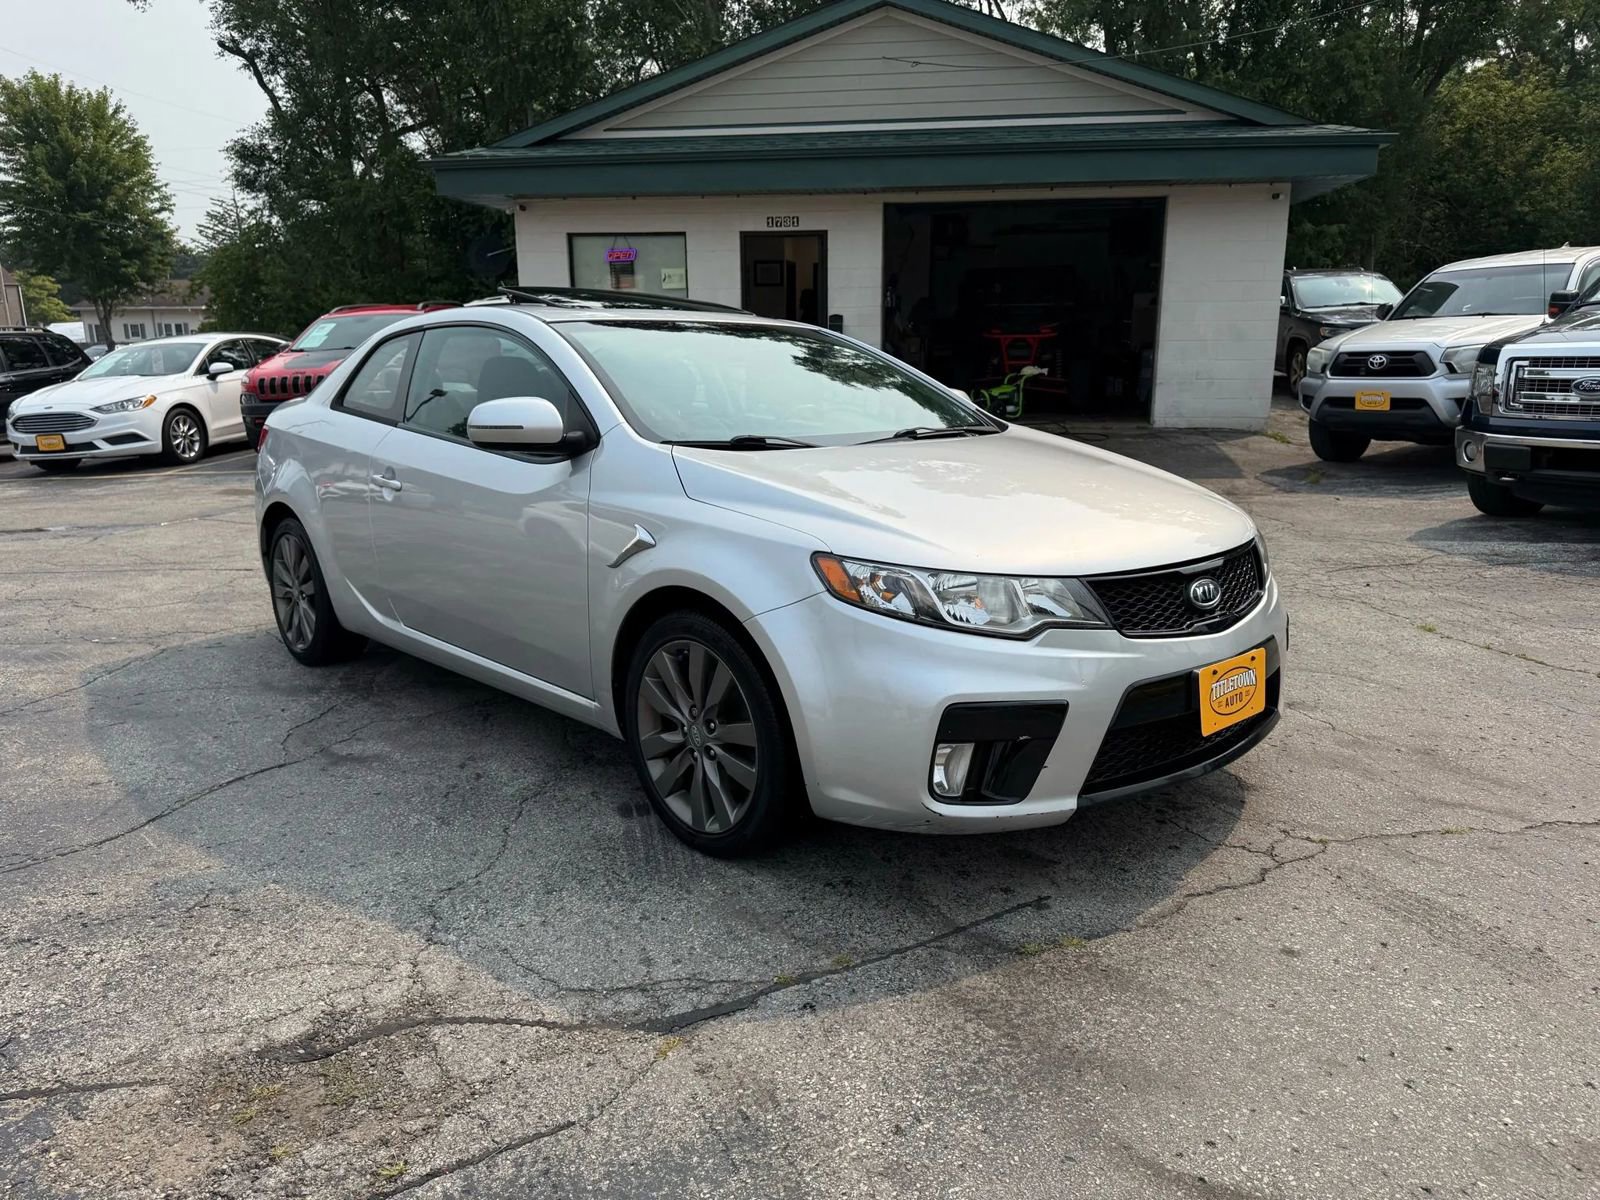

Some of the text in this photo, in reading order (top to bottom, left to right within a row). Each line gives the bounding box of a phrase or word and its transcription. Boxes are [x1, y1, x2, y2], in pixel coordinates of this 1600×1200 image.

[608, 251, 634, 260] OPEN
[1211, 668, 1256, 701] TITLETOWN
[1225, 691, 1243, 708] AUTO
